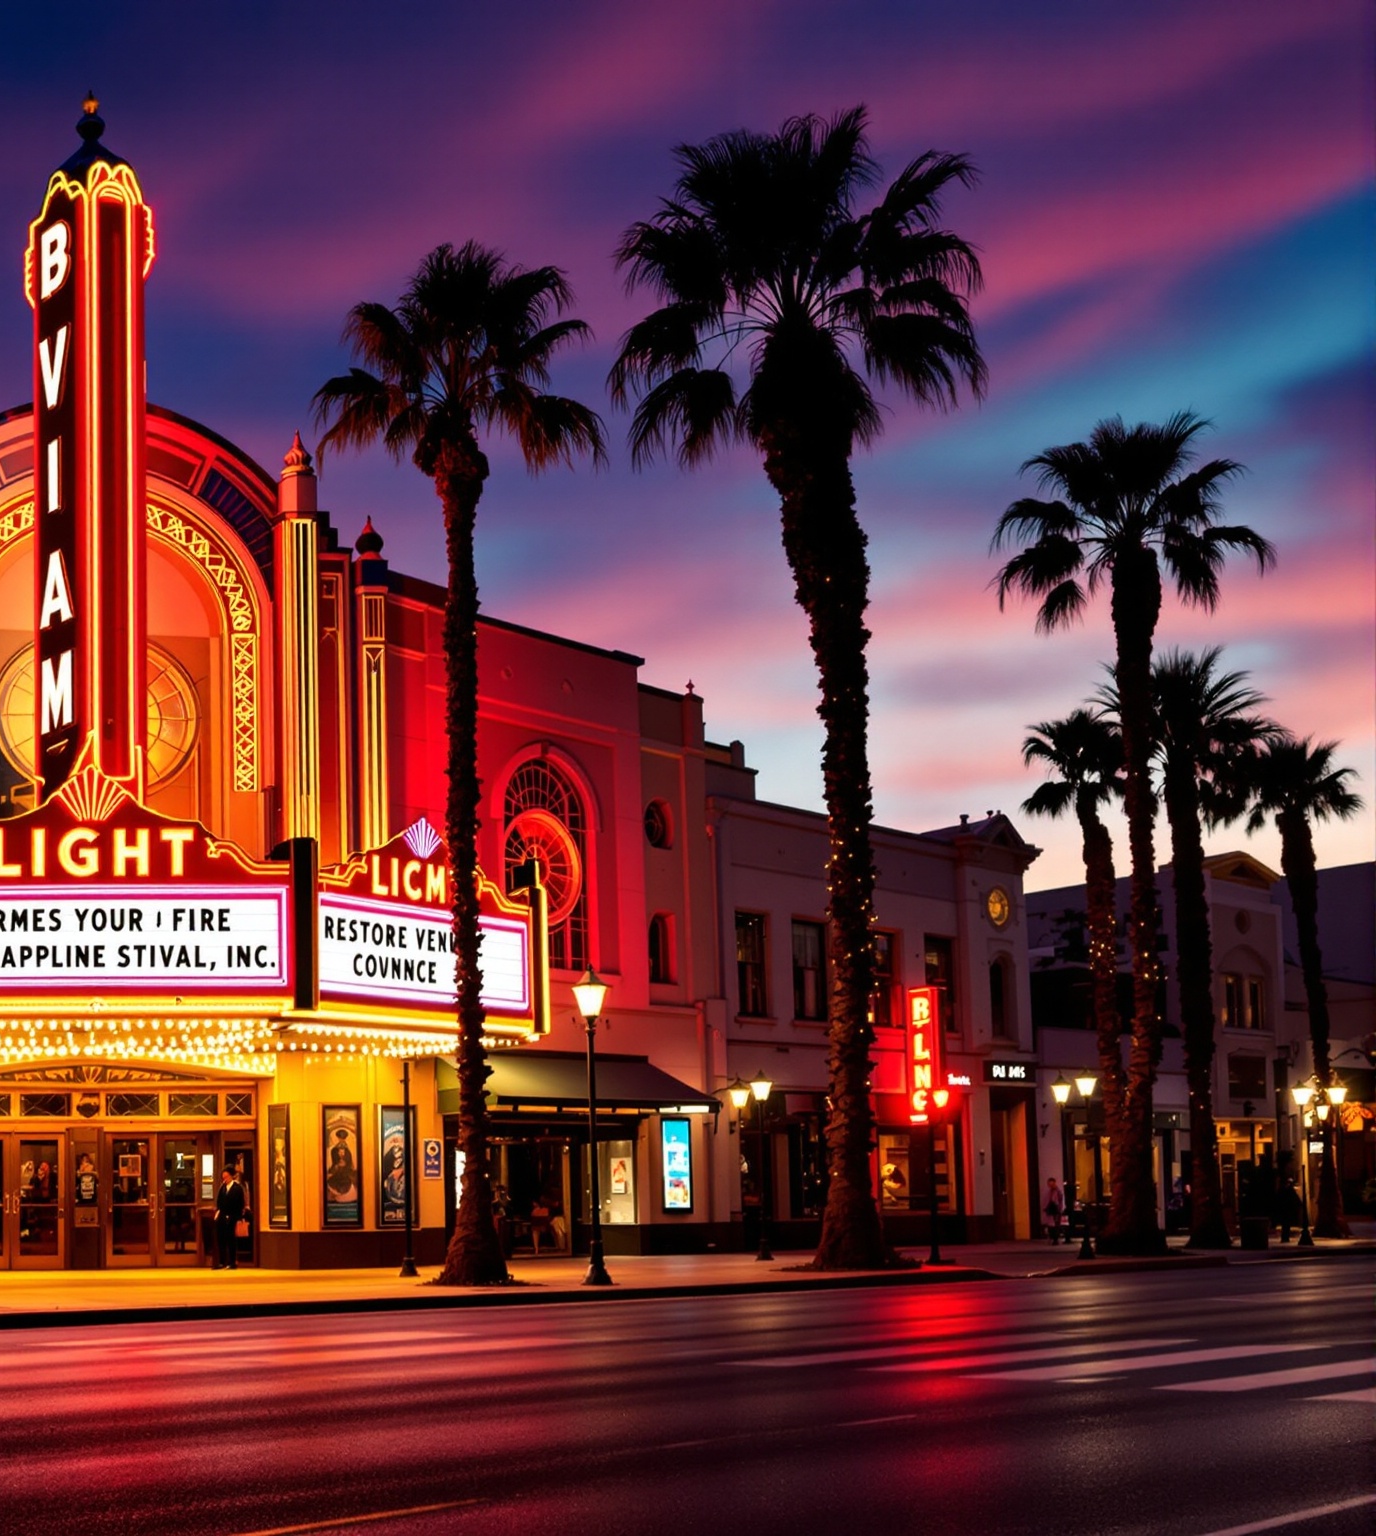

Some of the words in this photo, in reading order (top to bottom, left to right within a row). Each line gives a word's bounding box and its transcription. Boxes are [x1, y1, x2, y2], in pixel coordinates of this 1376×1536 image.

[39, 221, 73, 735] BVIAM
[370, 854, 446, 905] LICM
[74, 908, 143, 932] YOUR
[172, 908, 231, 932] FIRE
[324, 915, 408, 949] RESTORE
[117, 944, 217, 972] STIVAL,
[227, 946, 276, 969] INC.
